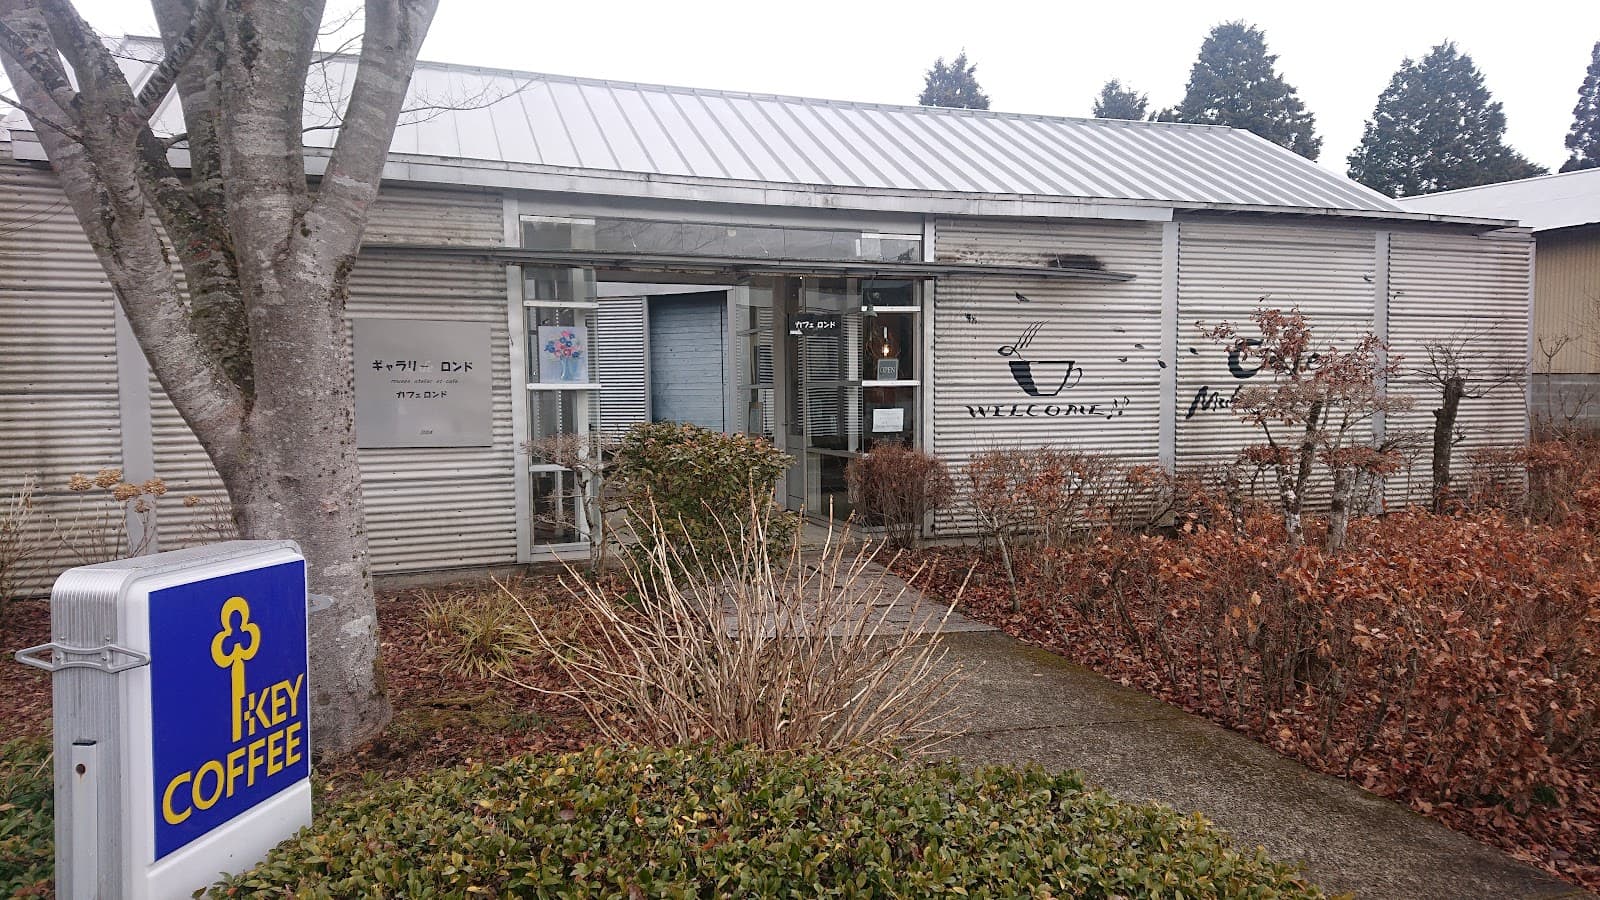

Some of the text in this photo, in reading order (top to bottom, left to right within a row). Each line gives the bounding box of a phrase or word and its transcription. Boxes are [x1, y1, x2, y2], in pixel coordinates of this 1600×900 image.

[795, 321, 836, 329] カフェ ロンド
[372, 360, 473, 372] ギャラリー ロンド
[880, 365, 896, 375] OPEN
[965, 404, 1105, 418] WELCOME
[246, 673, 304, 735] KEY
[162, 721, 302, 825] COFFEE
